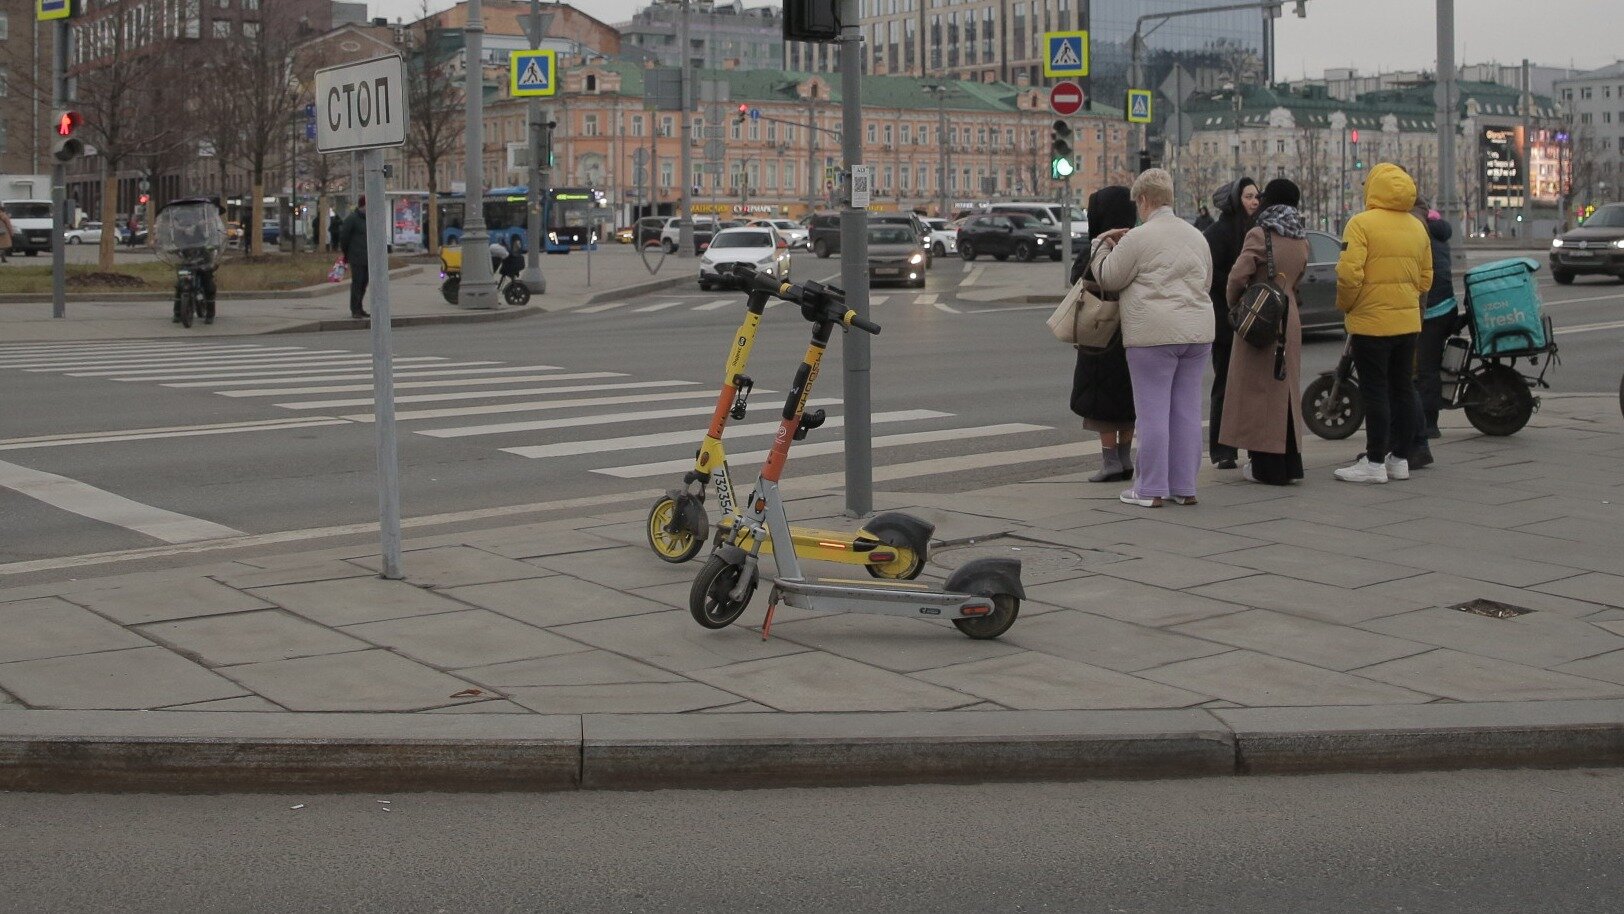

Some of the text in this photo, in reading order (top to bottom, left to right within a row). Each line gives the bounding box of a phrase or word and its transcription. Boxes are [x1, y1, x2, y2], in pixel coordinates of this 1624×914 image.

[328, 77, 390, 131] СТОП
[1484, 308, 1526, 329] fresh
[713, 470, 734, 515] 732354
